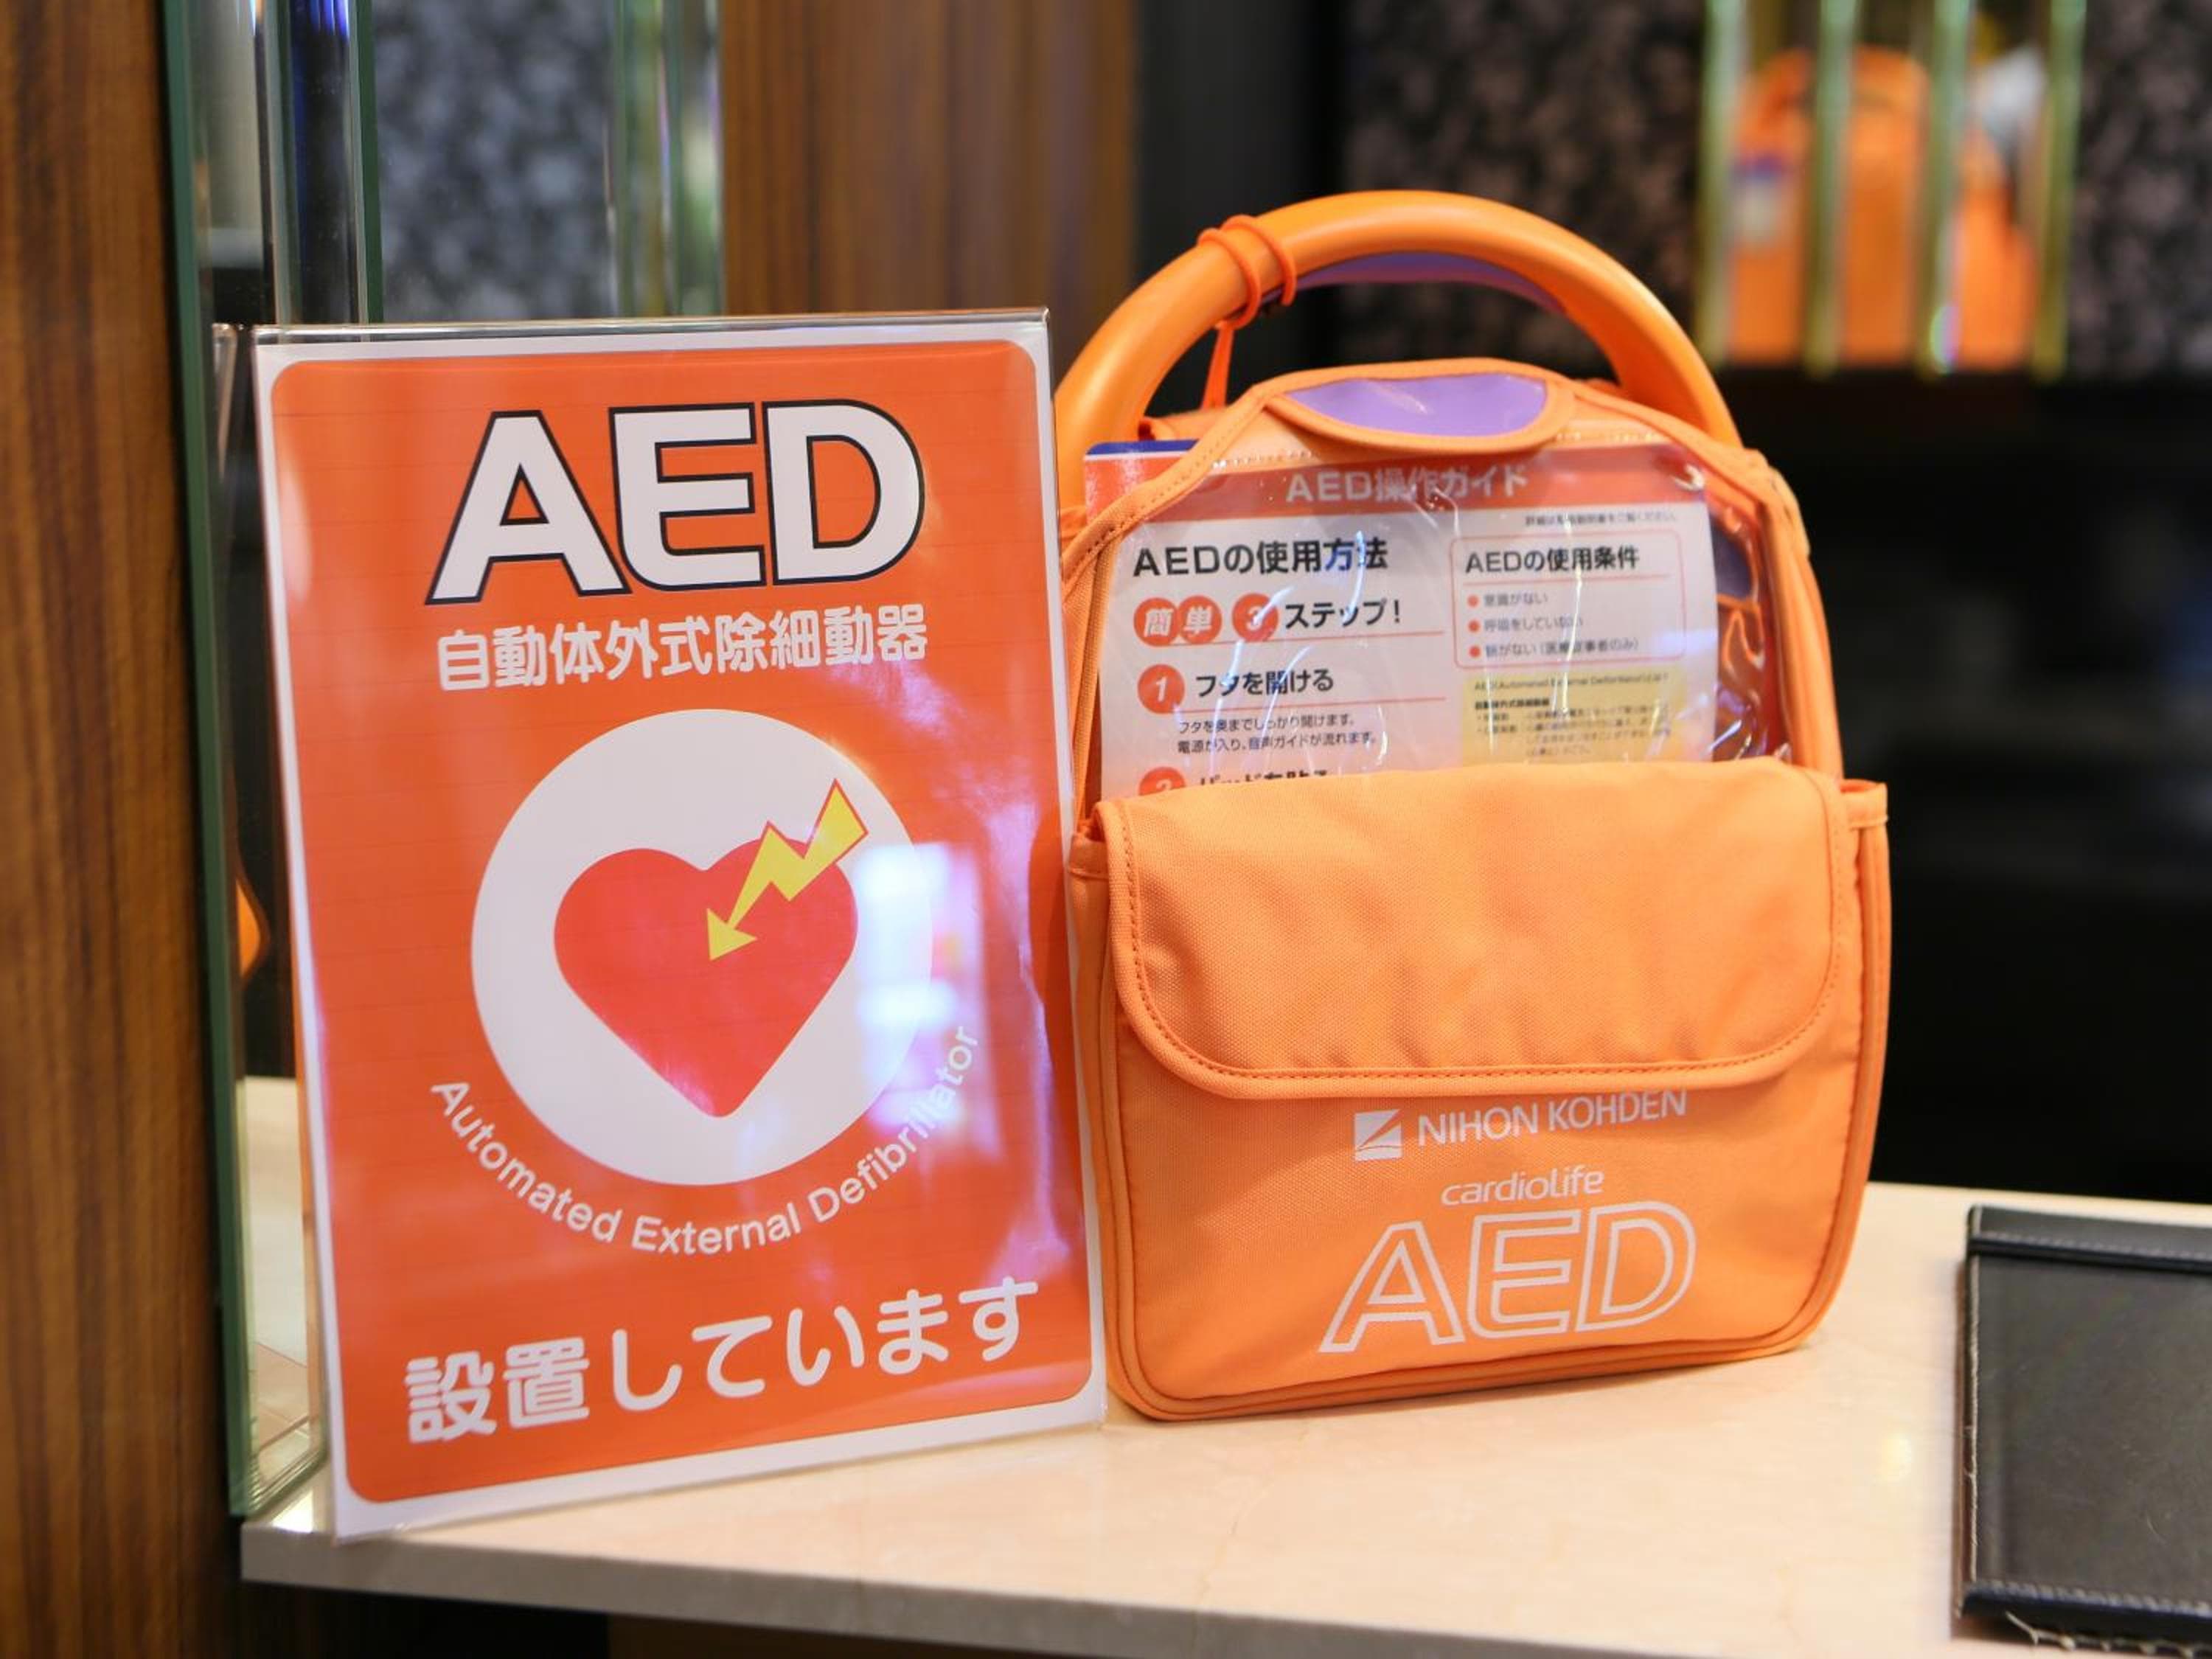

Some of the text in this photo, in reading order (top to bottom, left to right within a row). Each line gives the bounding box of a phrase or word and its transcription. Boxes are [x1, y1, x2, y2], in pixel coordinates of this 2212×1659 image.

[425, 399, 925, 605] AED
[1133, 538, 1388, 577] AEDの使用方法
[1465, 544, 1641, 573] AEDの使用条件
[438, 603, 928, 691] 自動体外式除細動器
[1195, 669, 1335, 698] フタを開ける
[431, 1026, 978, 1256] Automated External Defibrillator
[1418, 1090, 1687, 1146] NIHON KOHDEN
[1318, 1200, 1696, 1352] AED
[404, 1275, 1038, 1444] 設置しています
